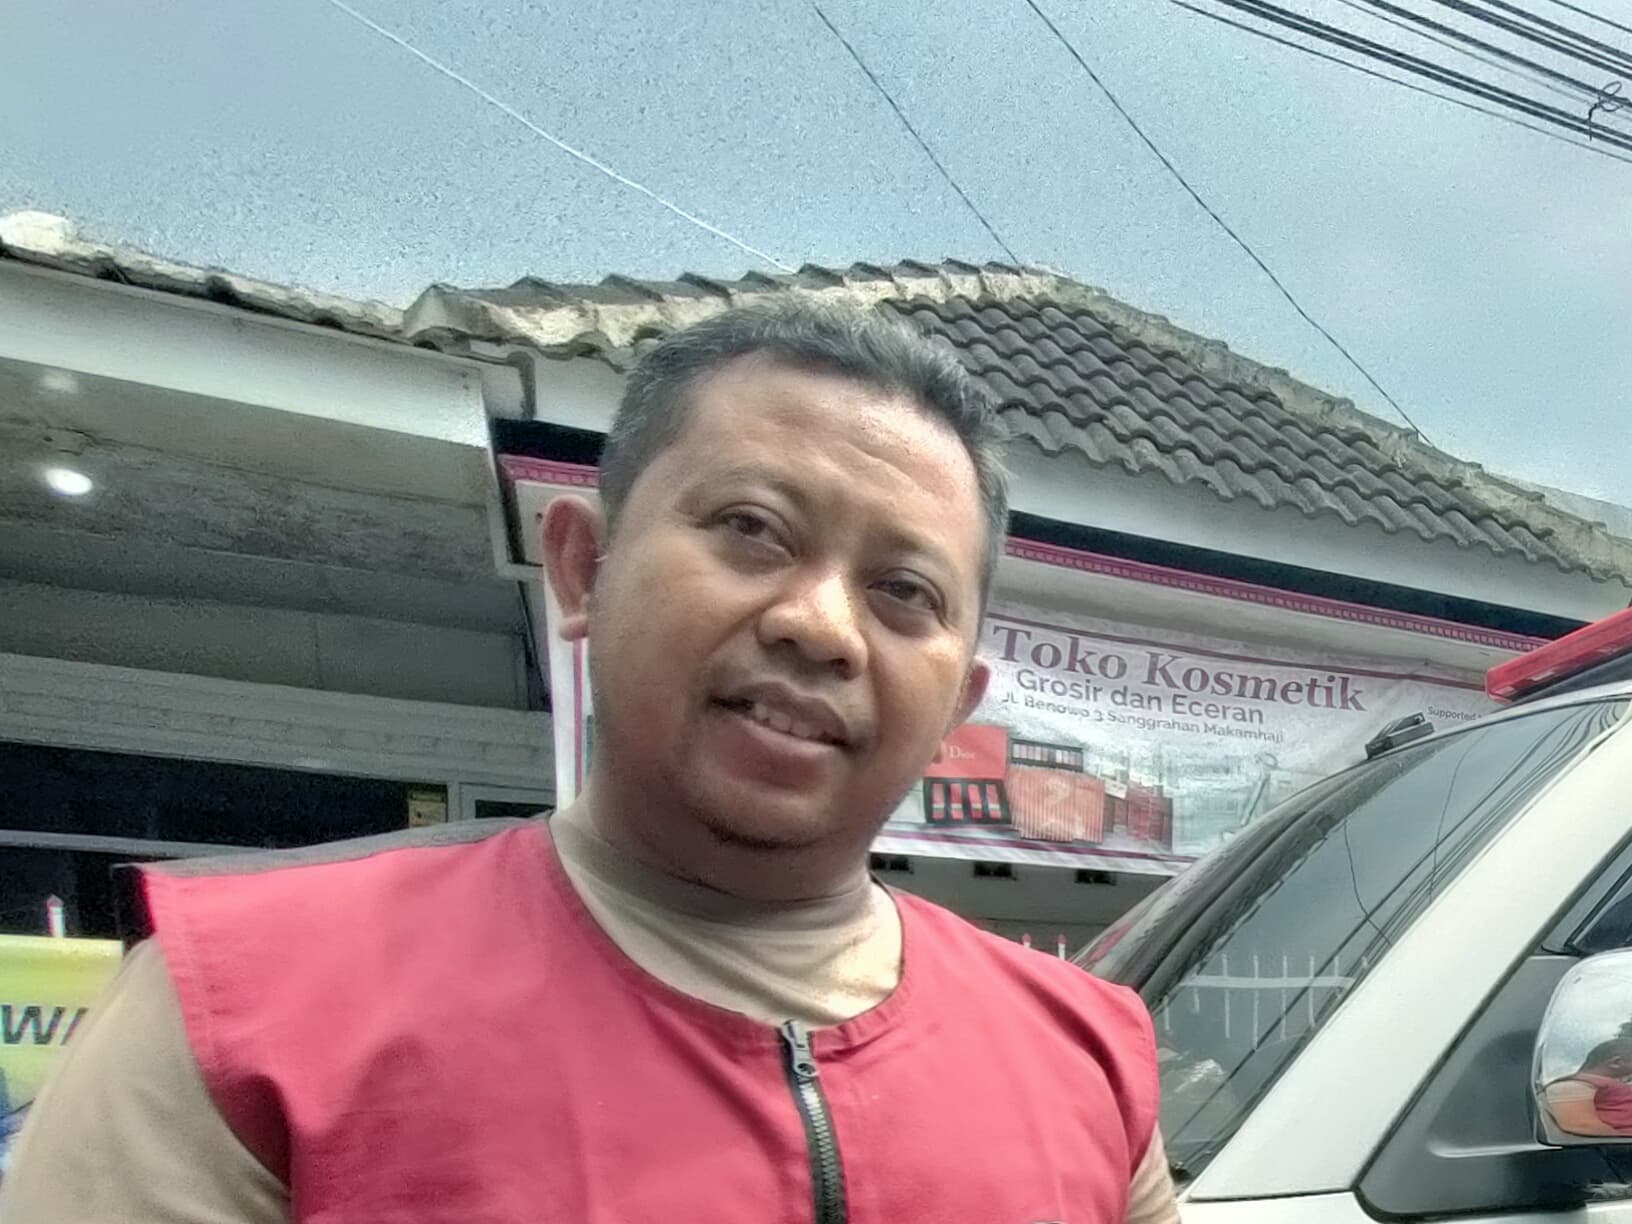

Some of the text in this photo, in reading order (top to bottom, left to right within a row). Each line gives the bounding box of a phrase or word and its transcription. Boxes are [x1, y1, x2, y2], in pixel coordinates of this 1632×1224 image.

[992, 625, 1367, 711] Toko Kosmetik
[1017, 669, 1263, 724] Grosir dan Eceran
